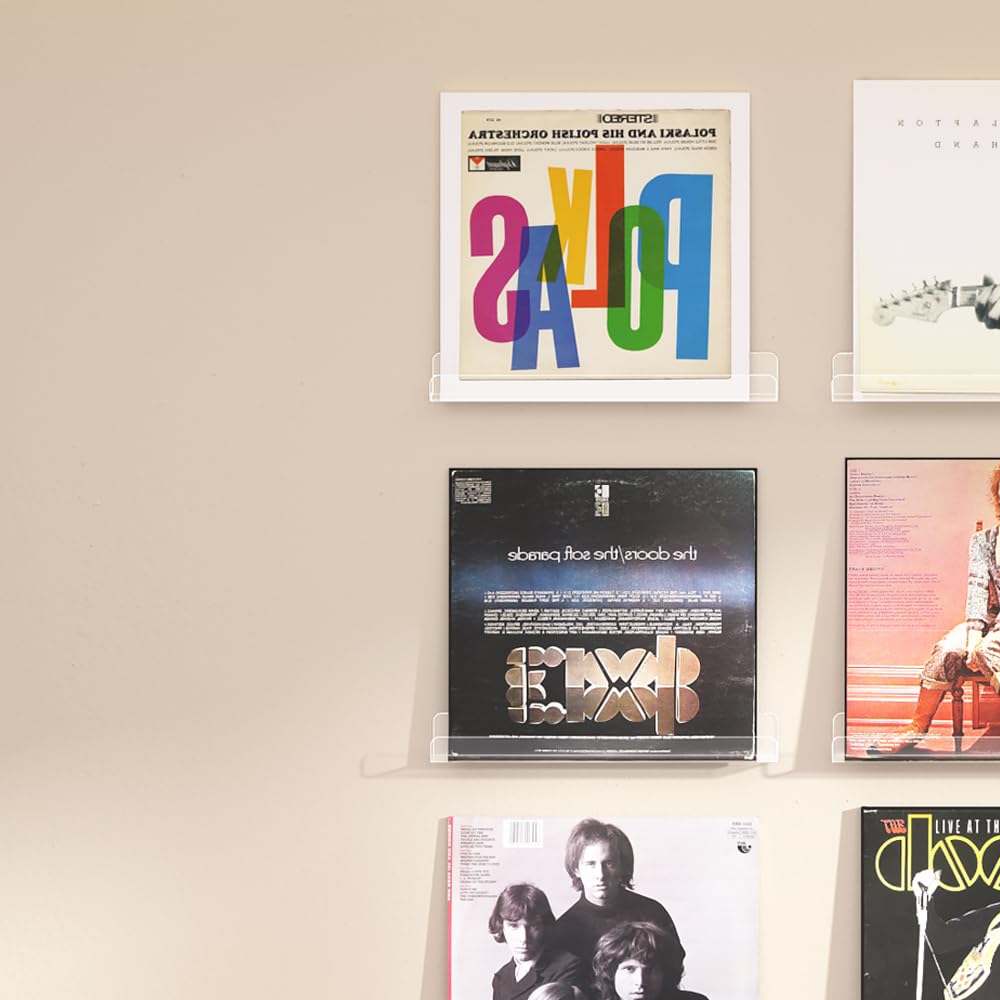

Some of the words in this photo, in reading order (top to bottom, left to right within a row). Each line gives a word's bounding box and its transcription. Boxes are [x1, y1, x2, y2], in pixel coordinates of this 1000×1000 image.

[881, 819, 907, 835] THE
[935, 819, 961, 835] LIVE
[966, 819, 980, 835] AT
